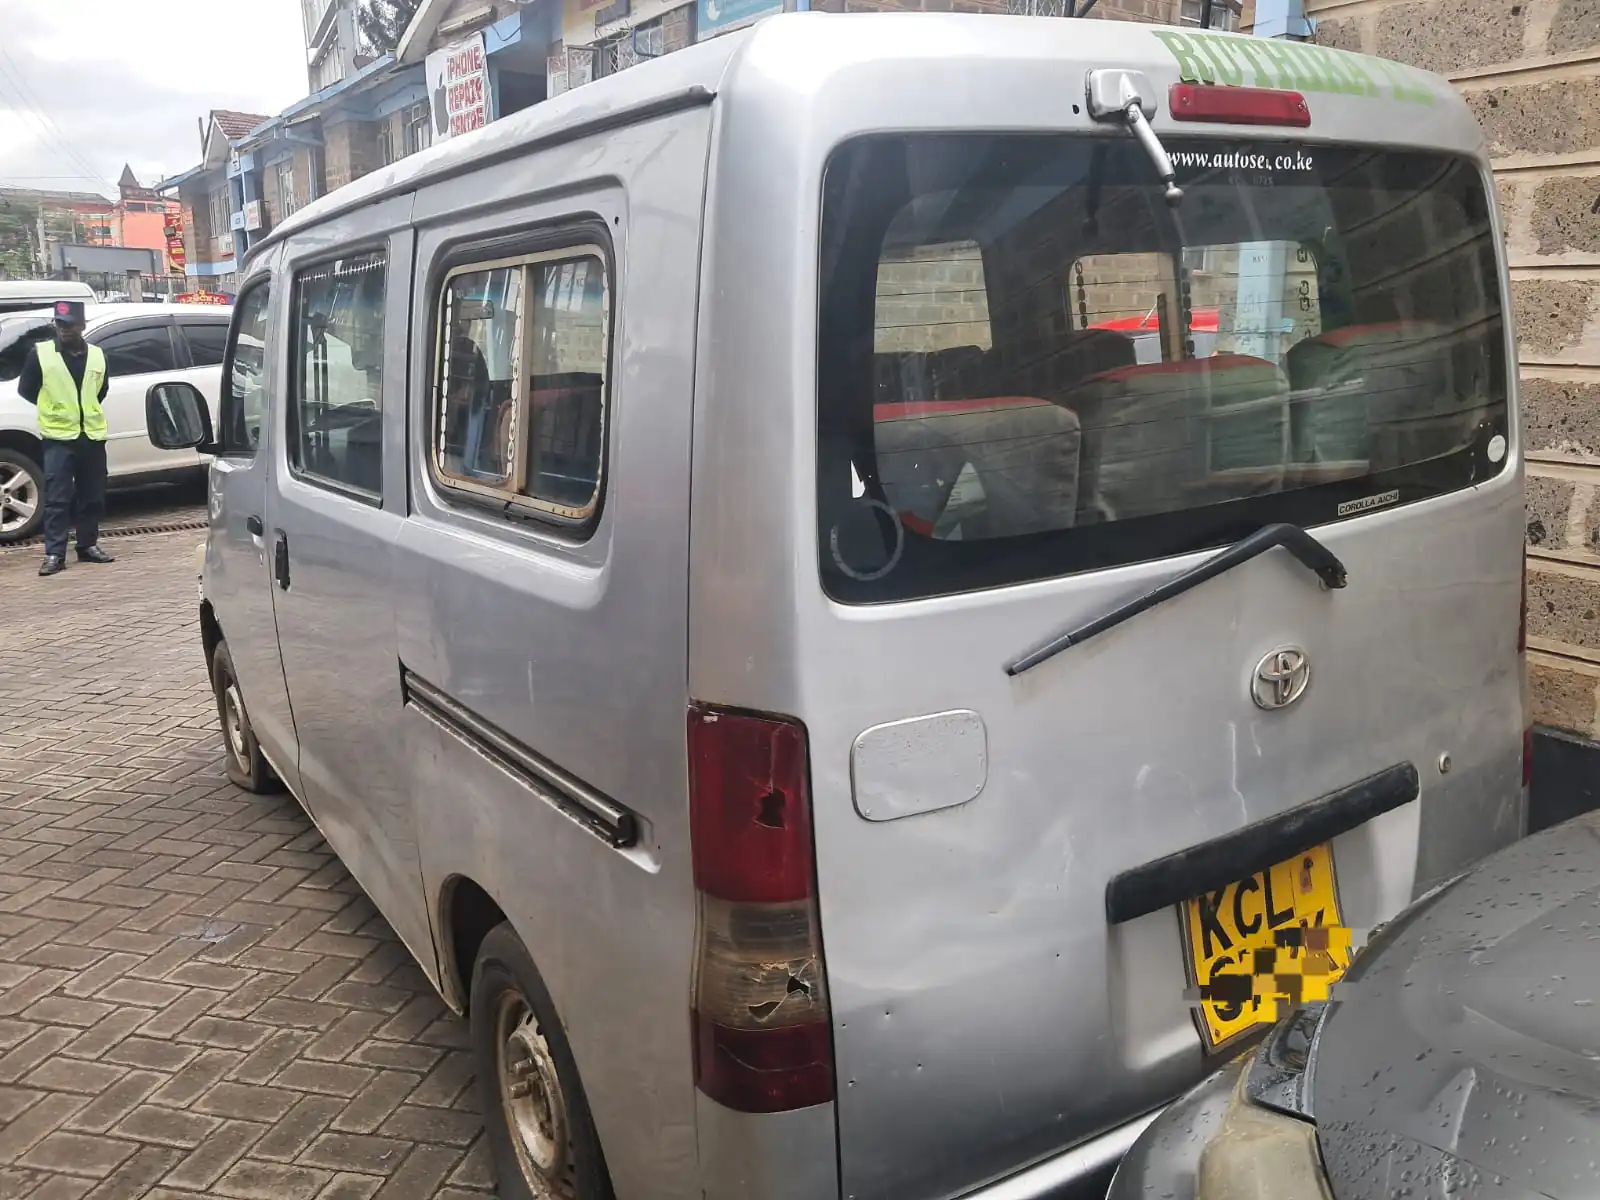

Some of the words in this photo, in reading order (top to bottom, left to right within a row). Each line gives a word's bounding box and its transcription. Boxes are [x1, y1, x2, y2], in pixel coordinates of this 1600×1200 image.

[447, 46, 482, 81] iPHONE
[1340, 498, 1375, 513] COROLLA
[1378, 491, 1398, 504] AICHI
[1198, 867, 1295, 959] KCL
